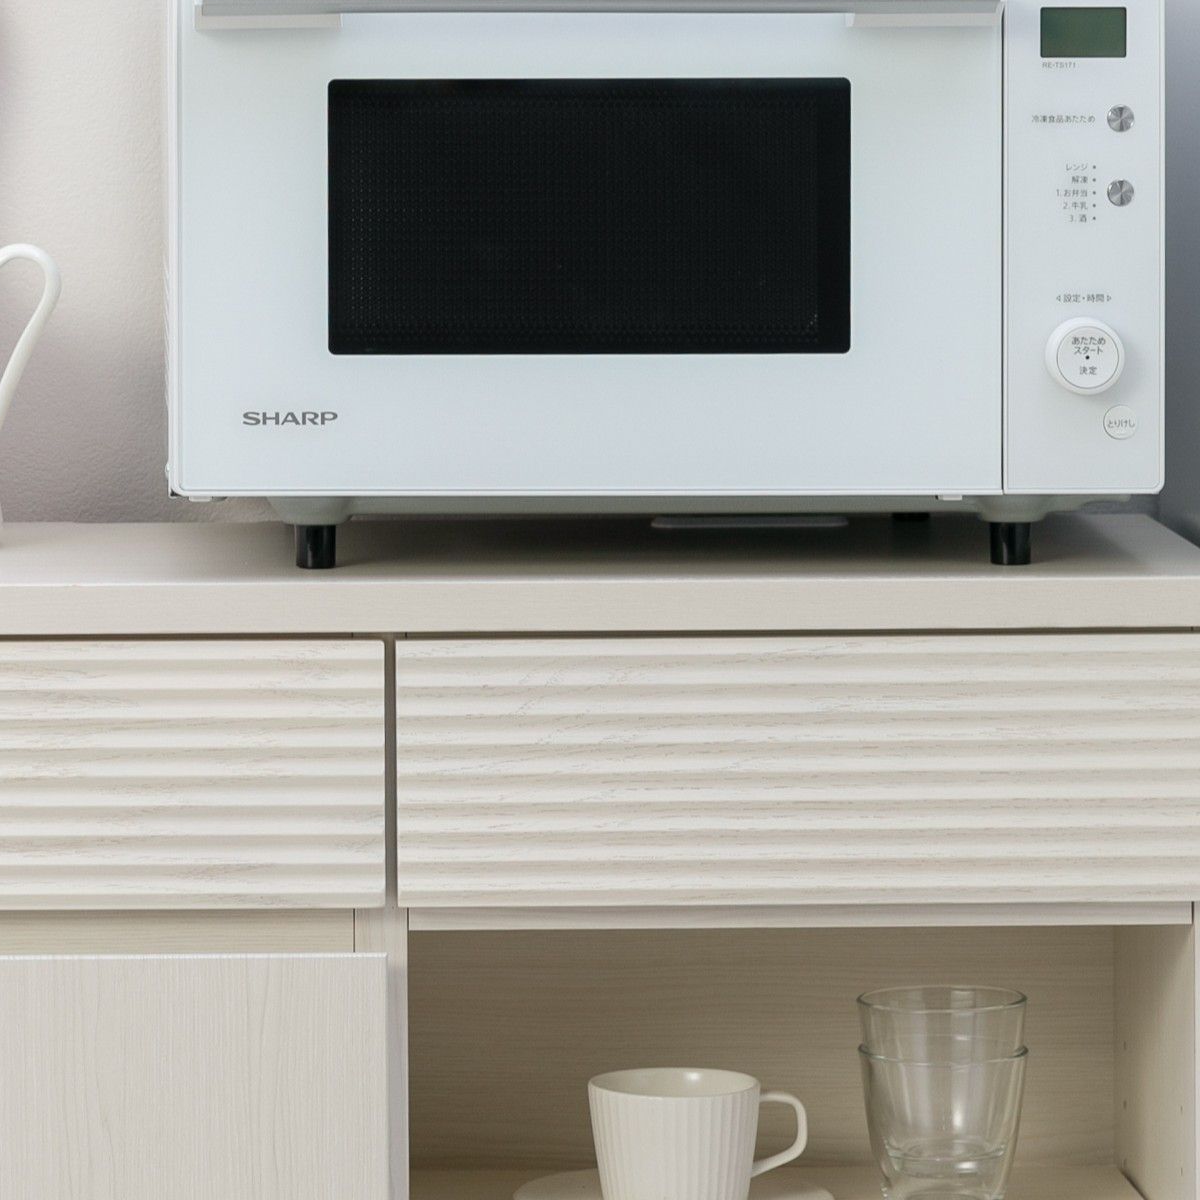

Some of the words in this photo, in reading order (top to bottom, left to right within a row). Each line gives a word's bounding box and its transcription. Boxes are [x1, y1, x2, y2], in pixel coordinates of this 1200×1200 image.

[1065, 163, 1088, 171] レンジ
[1071, 336, 1107, 346] あたため
[1073, 345, 1104, 355] スタート
[1079, 366, 1098, 375] 決定
[242, 411, 338, 426] SHARP
[1107, 419, 1136, 428] とりけし
